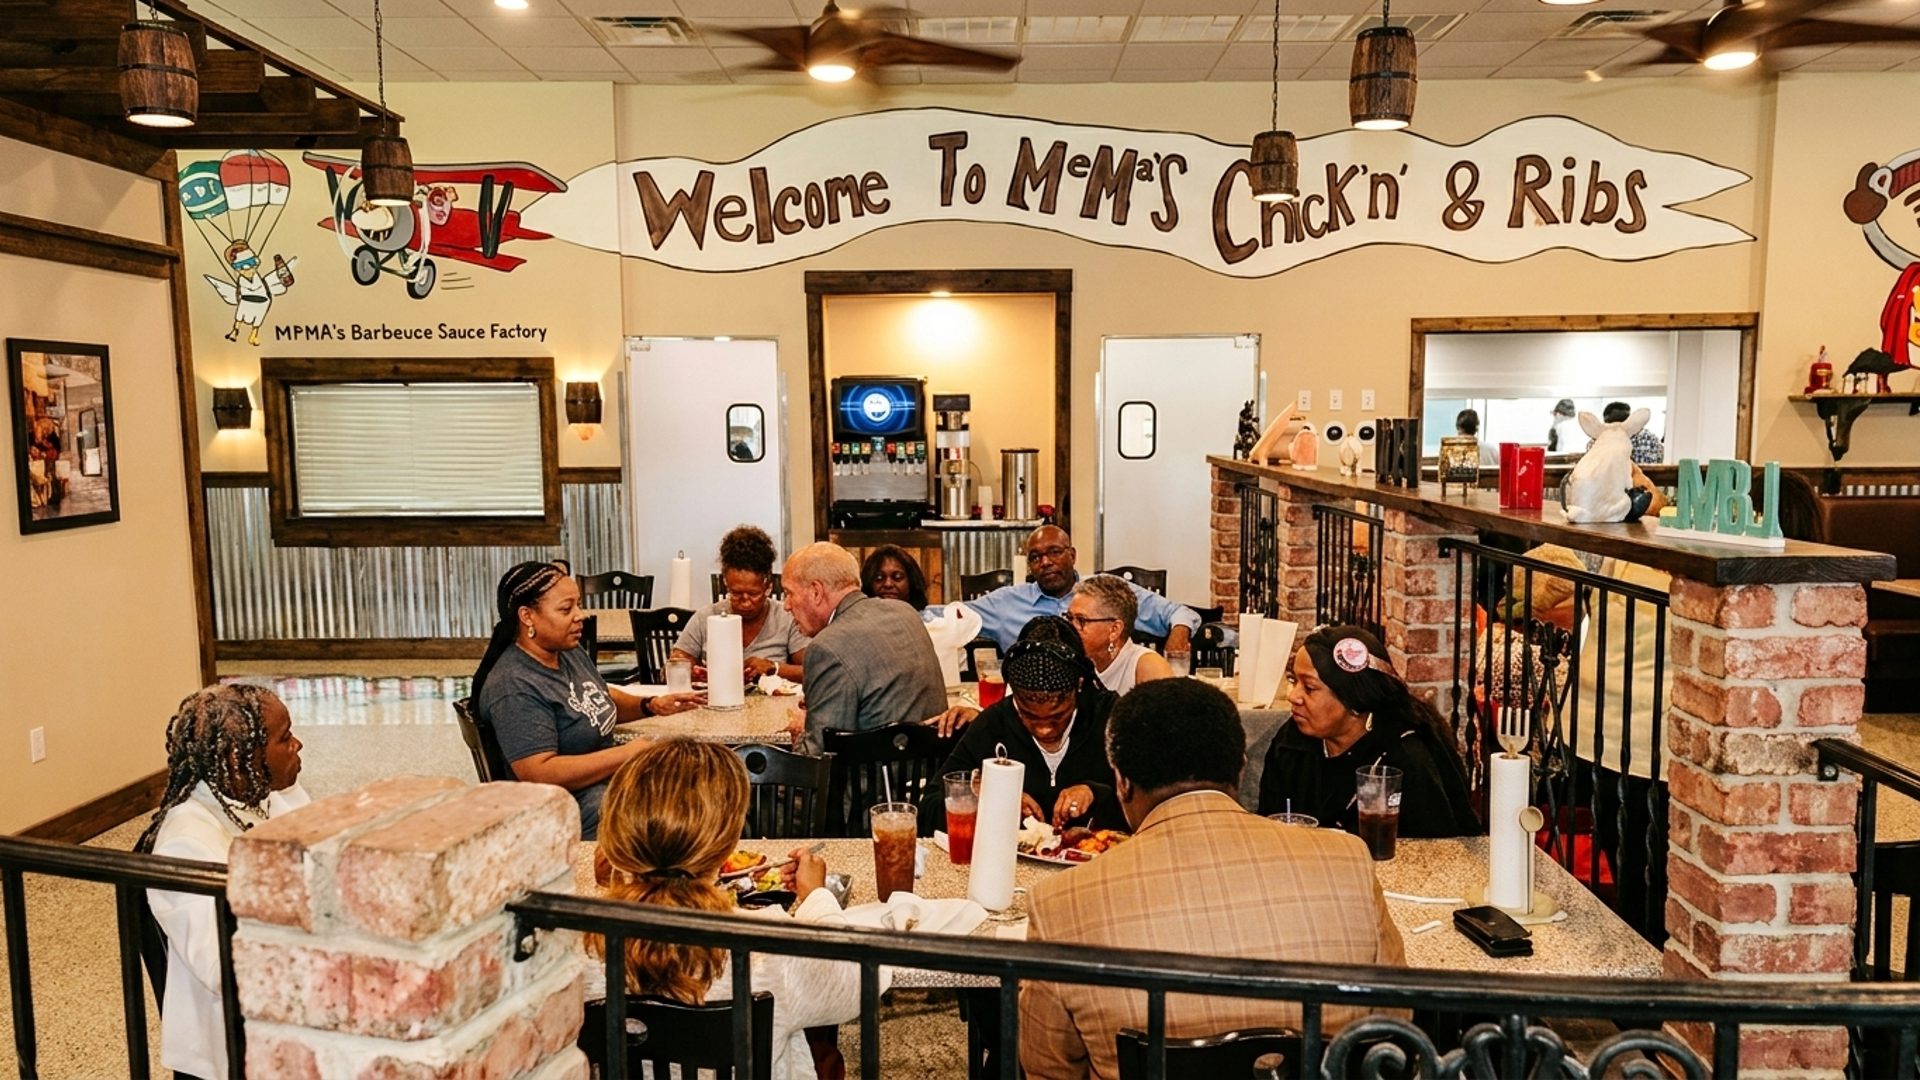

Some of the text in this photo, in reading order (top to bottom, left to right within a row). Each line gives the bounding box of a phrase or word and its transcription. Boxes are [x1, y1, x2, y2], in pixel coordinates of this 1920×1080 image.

[632, 166, 891, 251] Welcome
[928, 131, 987, 207] To
[1442, 160, 1485, 231] &
[275, 322, 547, 343] MPMA's Barbeuce Sauce Factory
